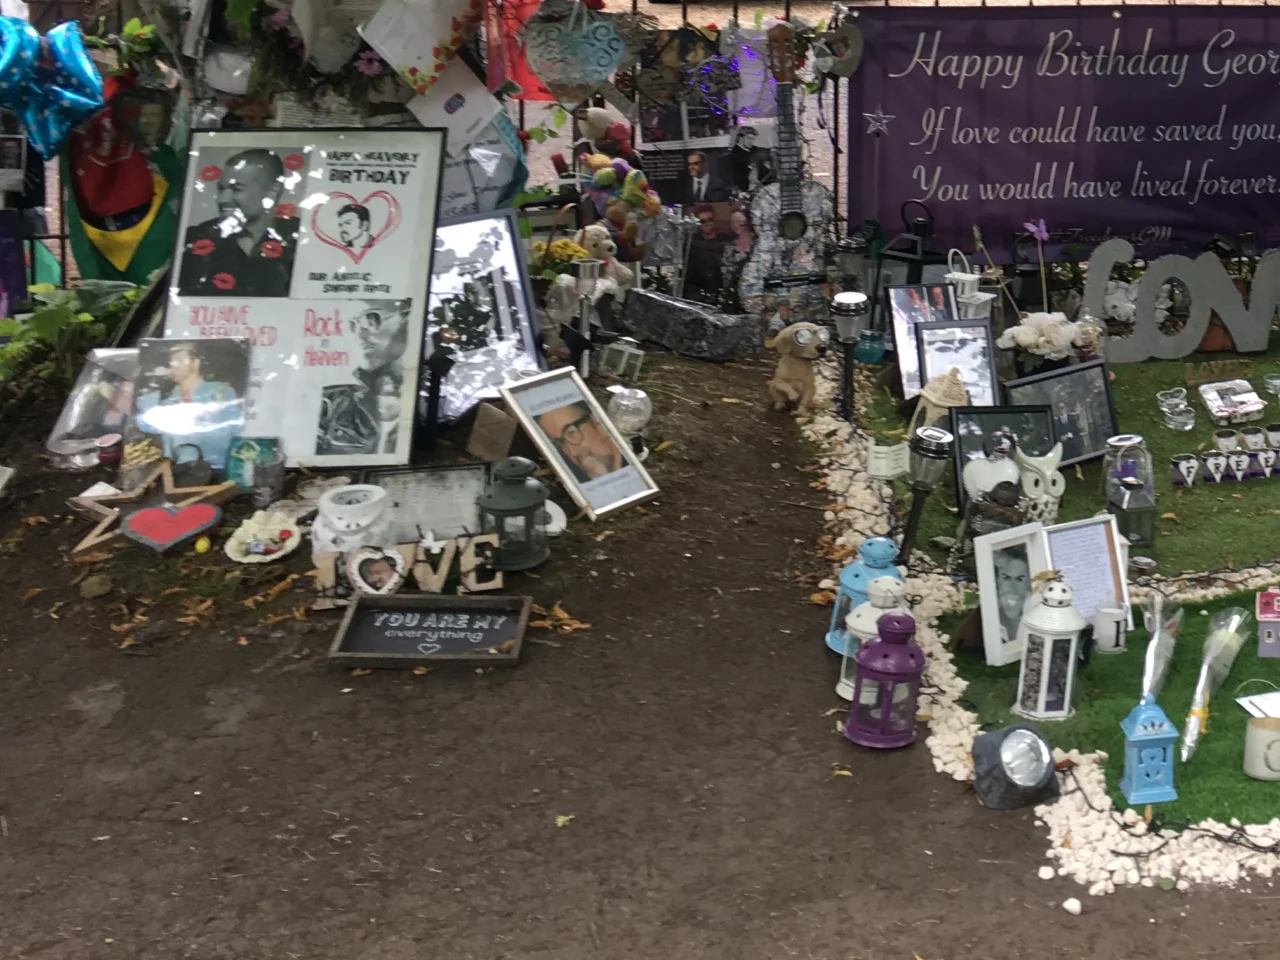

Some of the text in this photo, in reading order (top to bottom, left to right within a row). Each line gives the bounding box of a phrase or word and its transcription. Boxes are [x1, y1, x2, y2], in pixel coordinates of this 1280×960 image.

[889, 30, 1024, 89] Happy
[1036, 28, 1190, 88] Birthday
[909, 106, 951, 154] If
[951, 107, 1000, 145] love
[1008, 106, 1082, 145] could
[1086, 106, 1146, 143] have
[1154, 105, 1228, 142] saved
[329, 168, 411, 185] BIRTHDAY
[912, 164, 970, 203] You
[979, 162, 1057, 200] would
[1062, 161, 1124, 199] have
[1130, 160, 1193, 199] lived
[303, 308, 343, 337] Rock
[311, 533, 504, 611] LVE
[373, 612, 420, 627] YOU
[421, 613, 469, 629] ARE
[385, 628, 484, 642] everything
